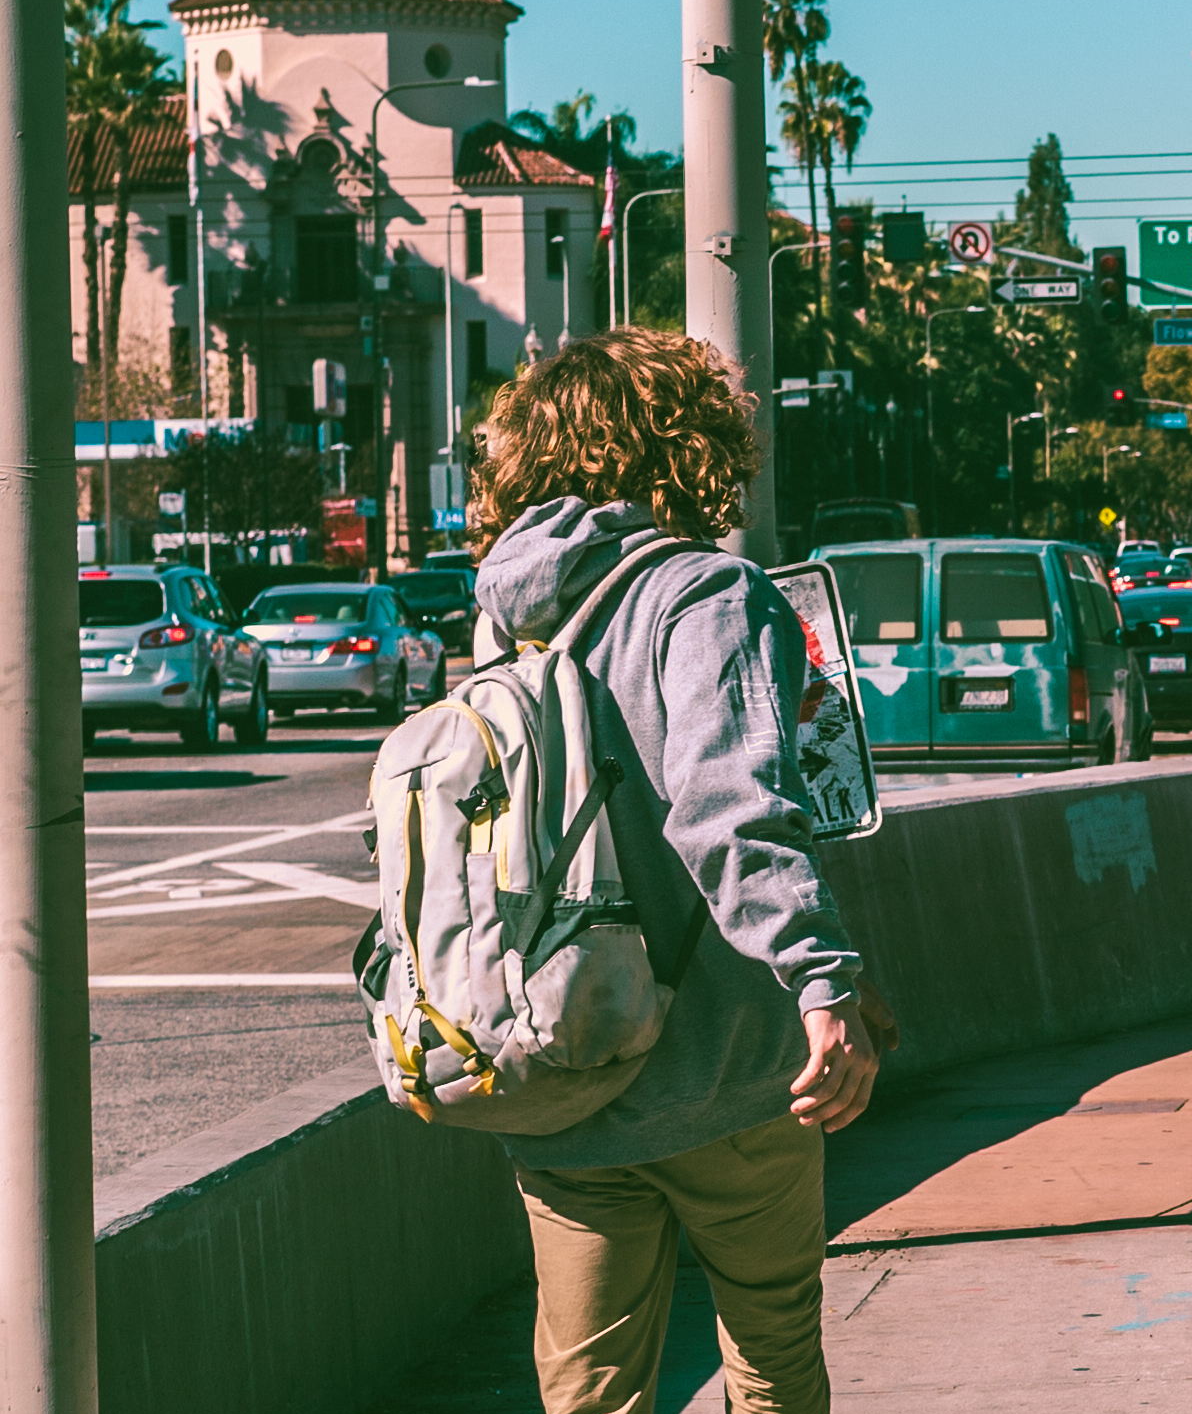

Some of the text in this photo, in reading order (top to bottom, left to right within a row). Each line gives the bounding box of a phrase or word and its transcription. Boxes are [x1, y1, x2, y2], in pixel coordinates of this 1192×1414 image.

[1154, 226, 1179, 244] To
[1048, 284, 1071, 294] WAY
[808, 788, 855, 823] ALK
